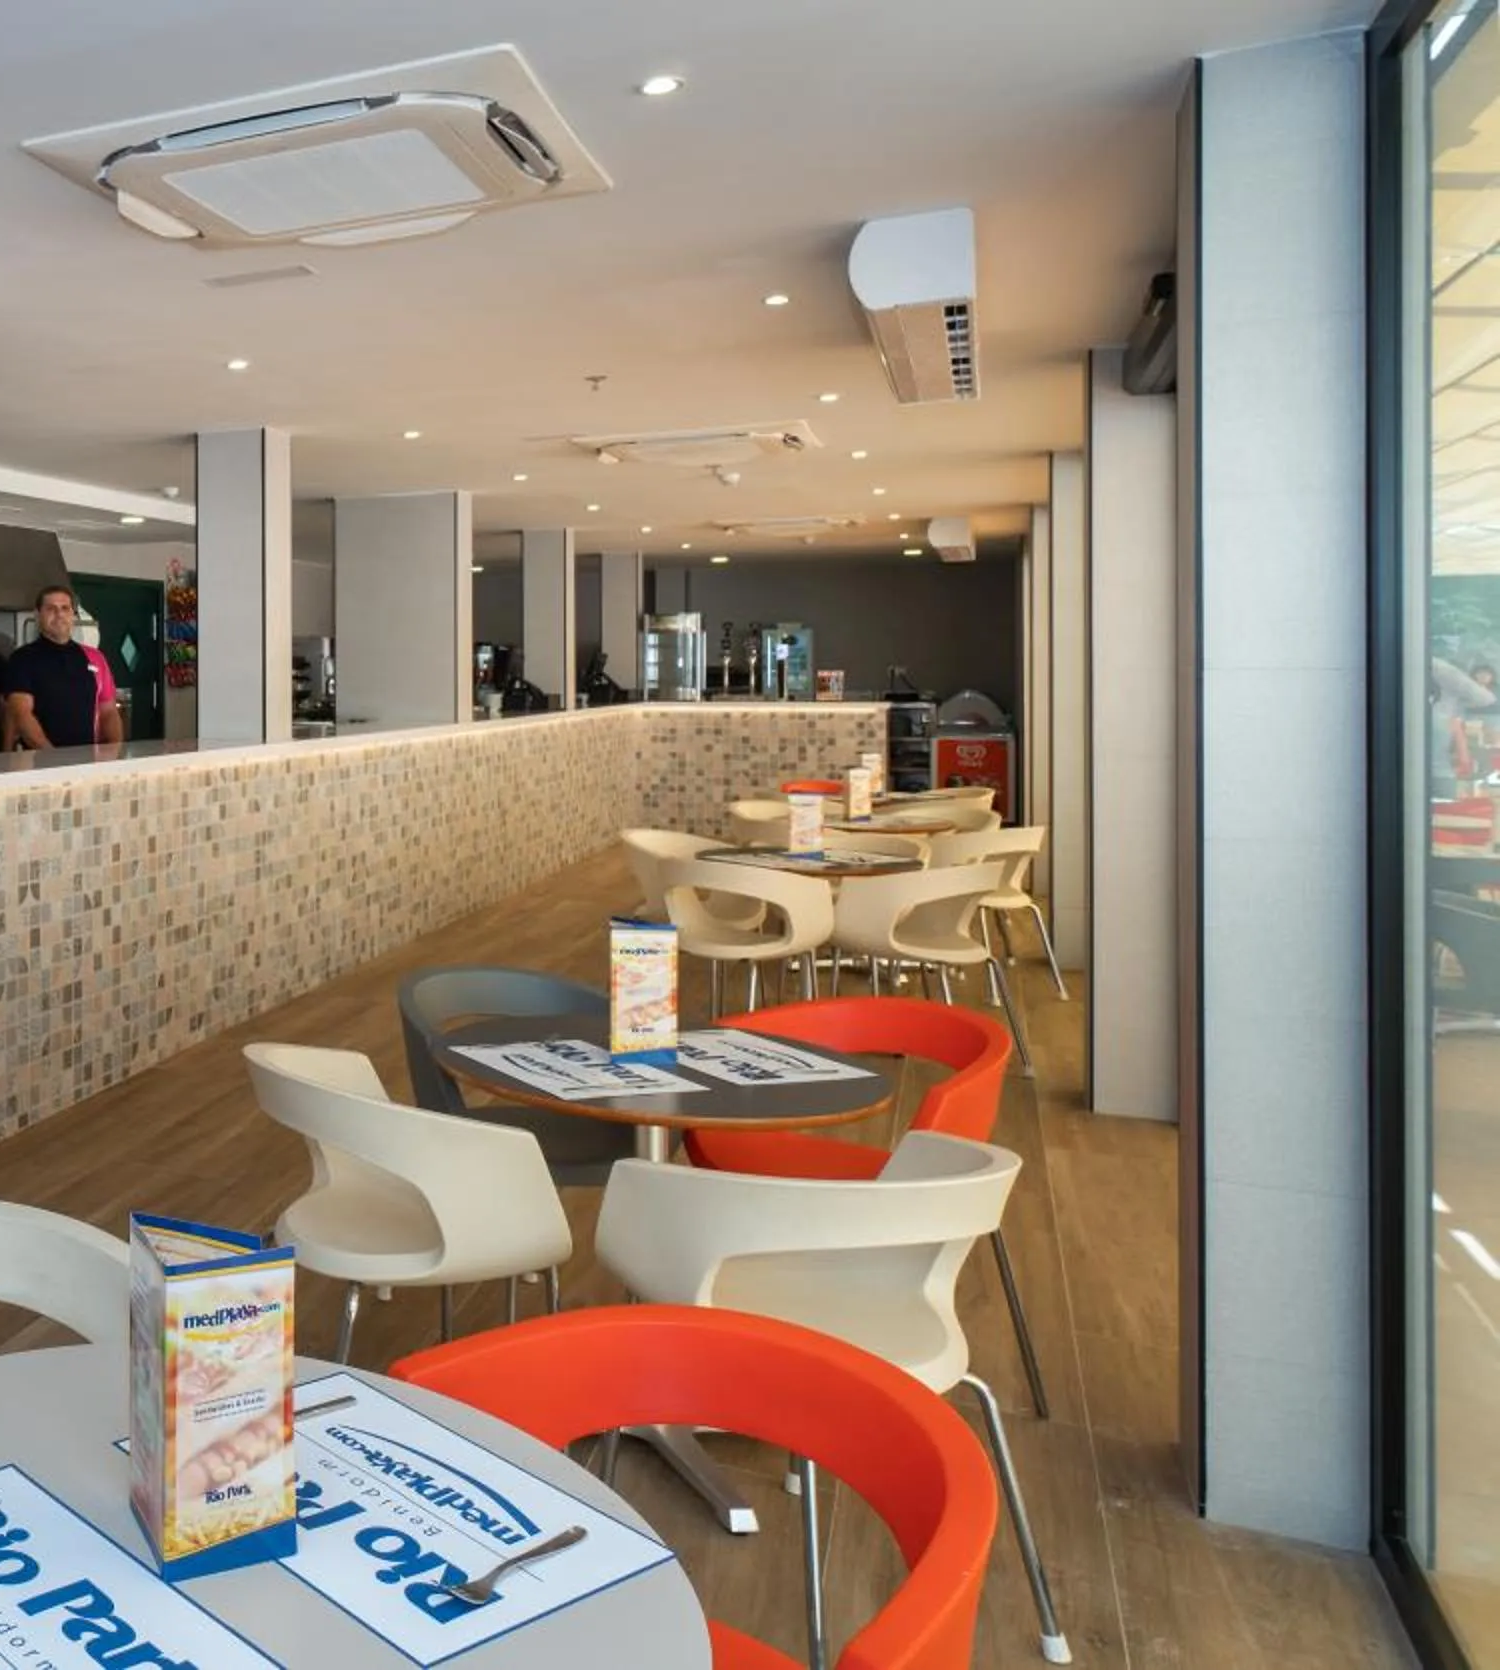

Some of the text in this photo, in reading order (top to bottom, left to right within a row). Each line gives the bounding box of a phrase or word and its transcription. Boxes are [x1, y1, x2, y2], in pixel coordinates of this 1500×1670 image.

[317, 1459, 443, 1537] Benidorm
[355, 1526, 505, 1624] Rio
[17, 1578, 200, 1670] Par
